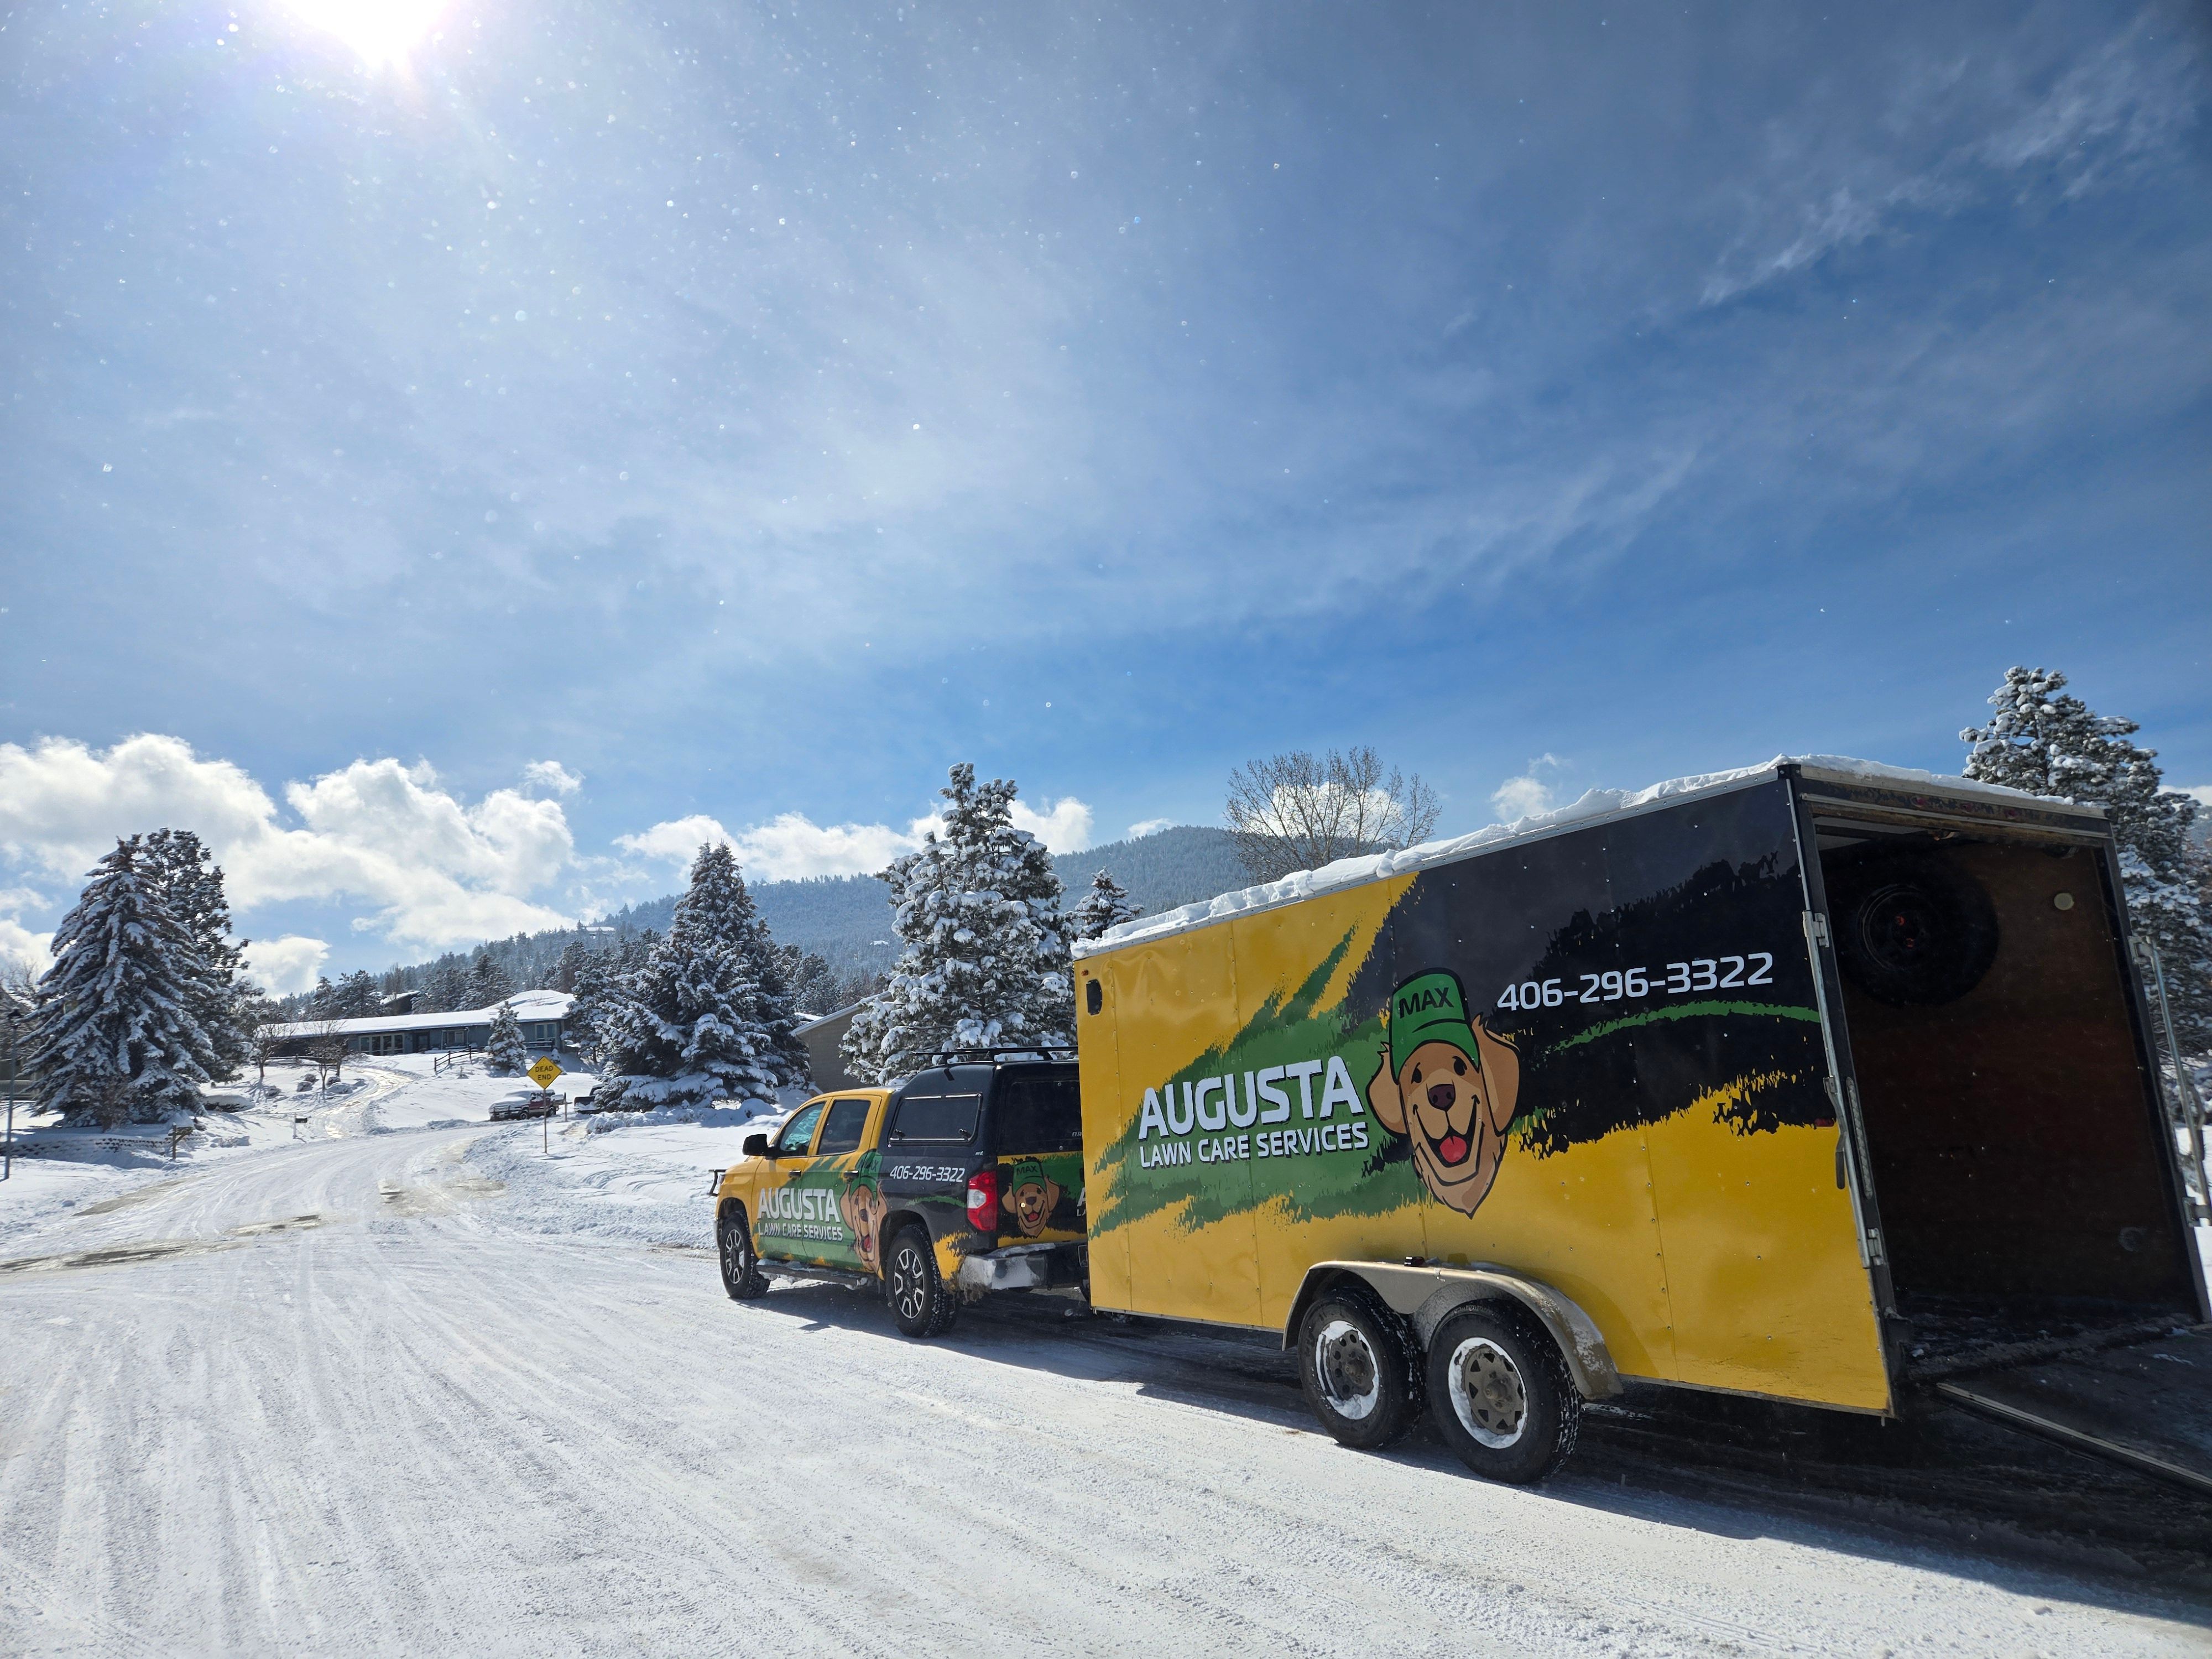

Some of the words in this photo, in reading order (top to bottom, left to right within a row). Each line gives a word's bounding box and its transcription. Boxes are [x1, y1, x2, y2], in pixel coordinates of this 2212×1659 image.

[1497, 952, 1773, 1011] 406-296-3322
[1399, 987, 1454, 1019] MAX
[1138, 1055, 1365, 1141] AUGUSTA
[1140, 1141, 1192, 1168] LAWN
[1198, 1134, 1250, 1162] CARE
[1256, 1121, 1369, 1158] SERVICES
[890, 1165, 966, 1182] 406-296-3322
[1016, 1165, 1039, 1175] MAX
[757, 1187, 841, 1223] AUGUSTA
[758, 1222, 780, 1237] LAWN
[782, 1223, 802, 1238] CARE
[803, 1224, 843, 1241] SERVICES
